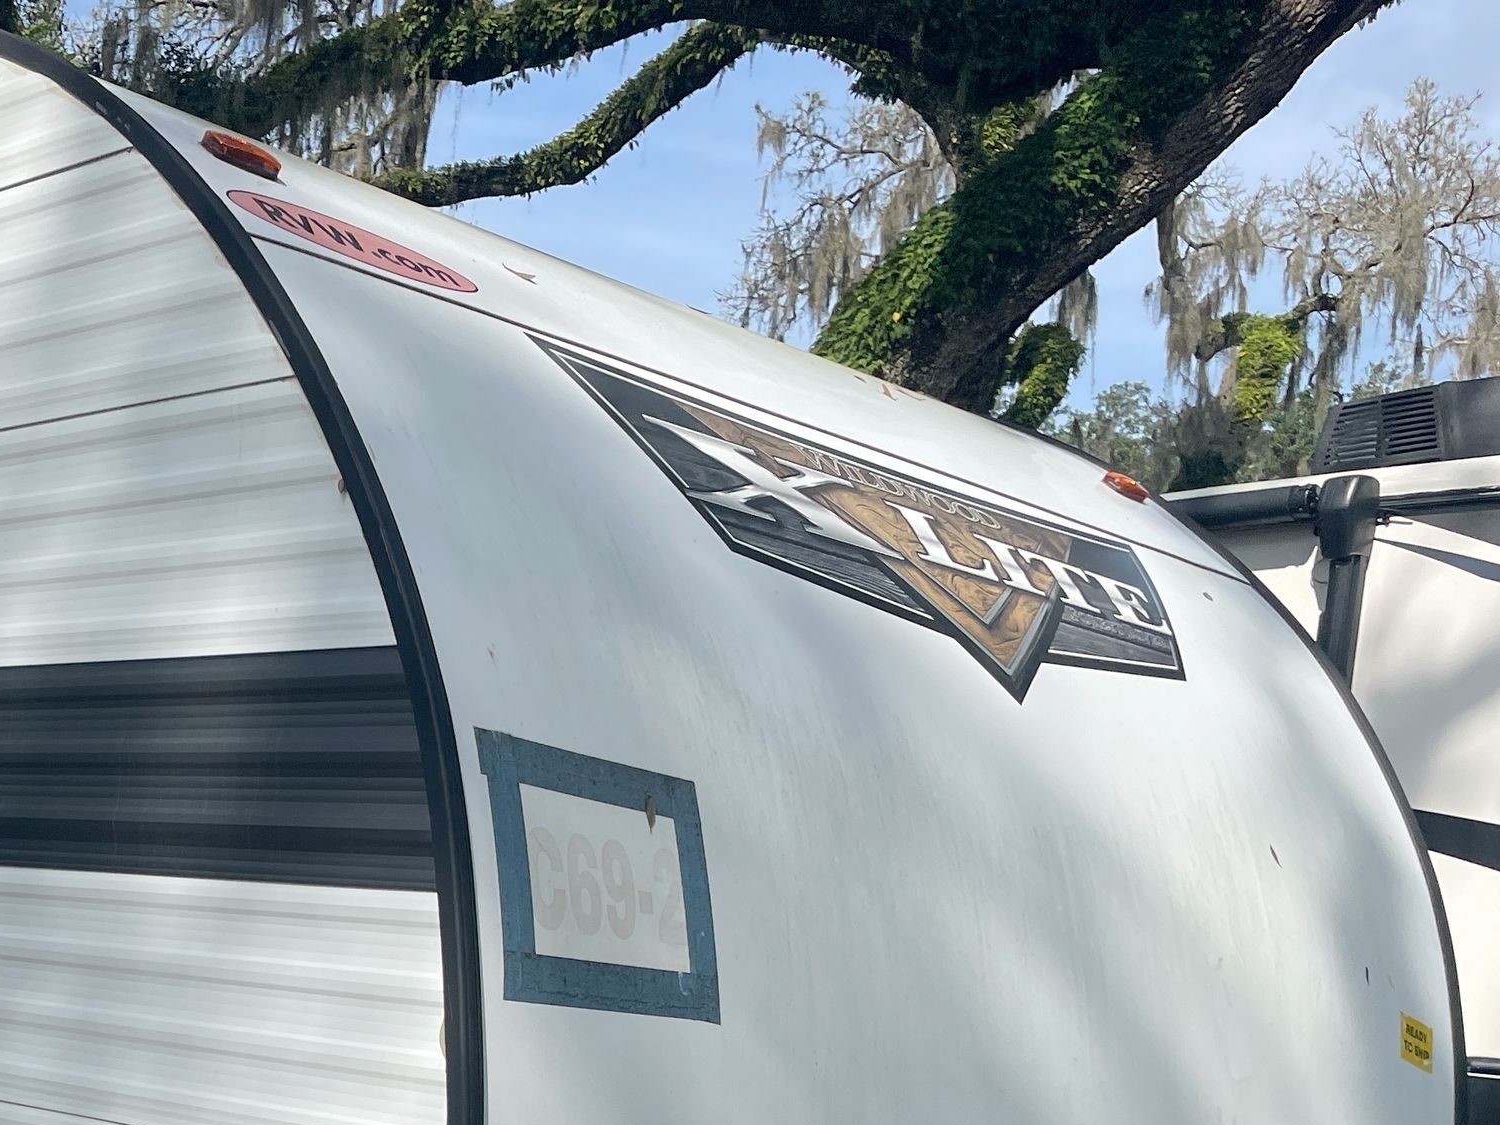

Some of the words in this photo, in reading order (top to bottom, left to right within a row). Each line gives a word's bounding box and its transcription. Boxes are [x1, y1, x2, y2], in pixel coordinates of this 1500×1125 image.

[789, 442, 1001, 529] WILDWOOD
[1405, 1023, 1427, 1043] READY
[1404, 1039, 1414, 1053] TO
